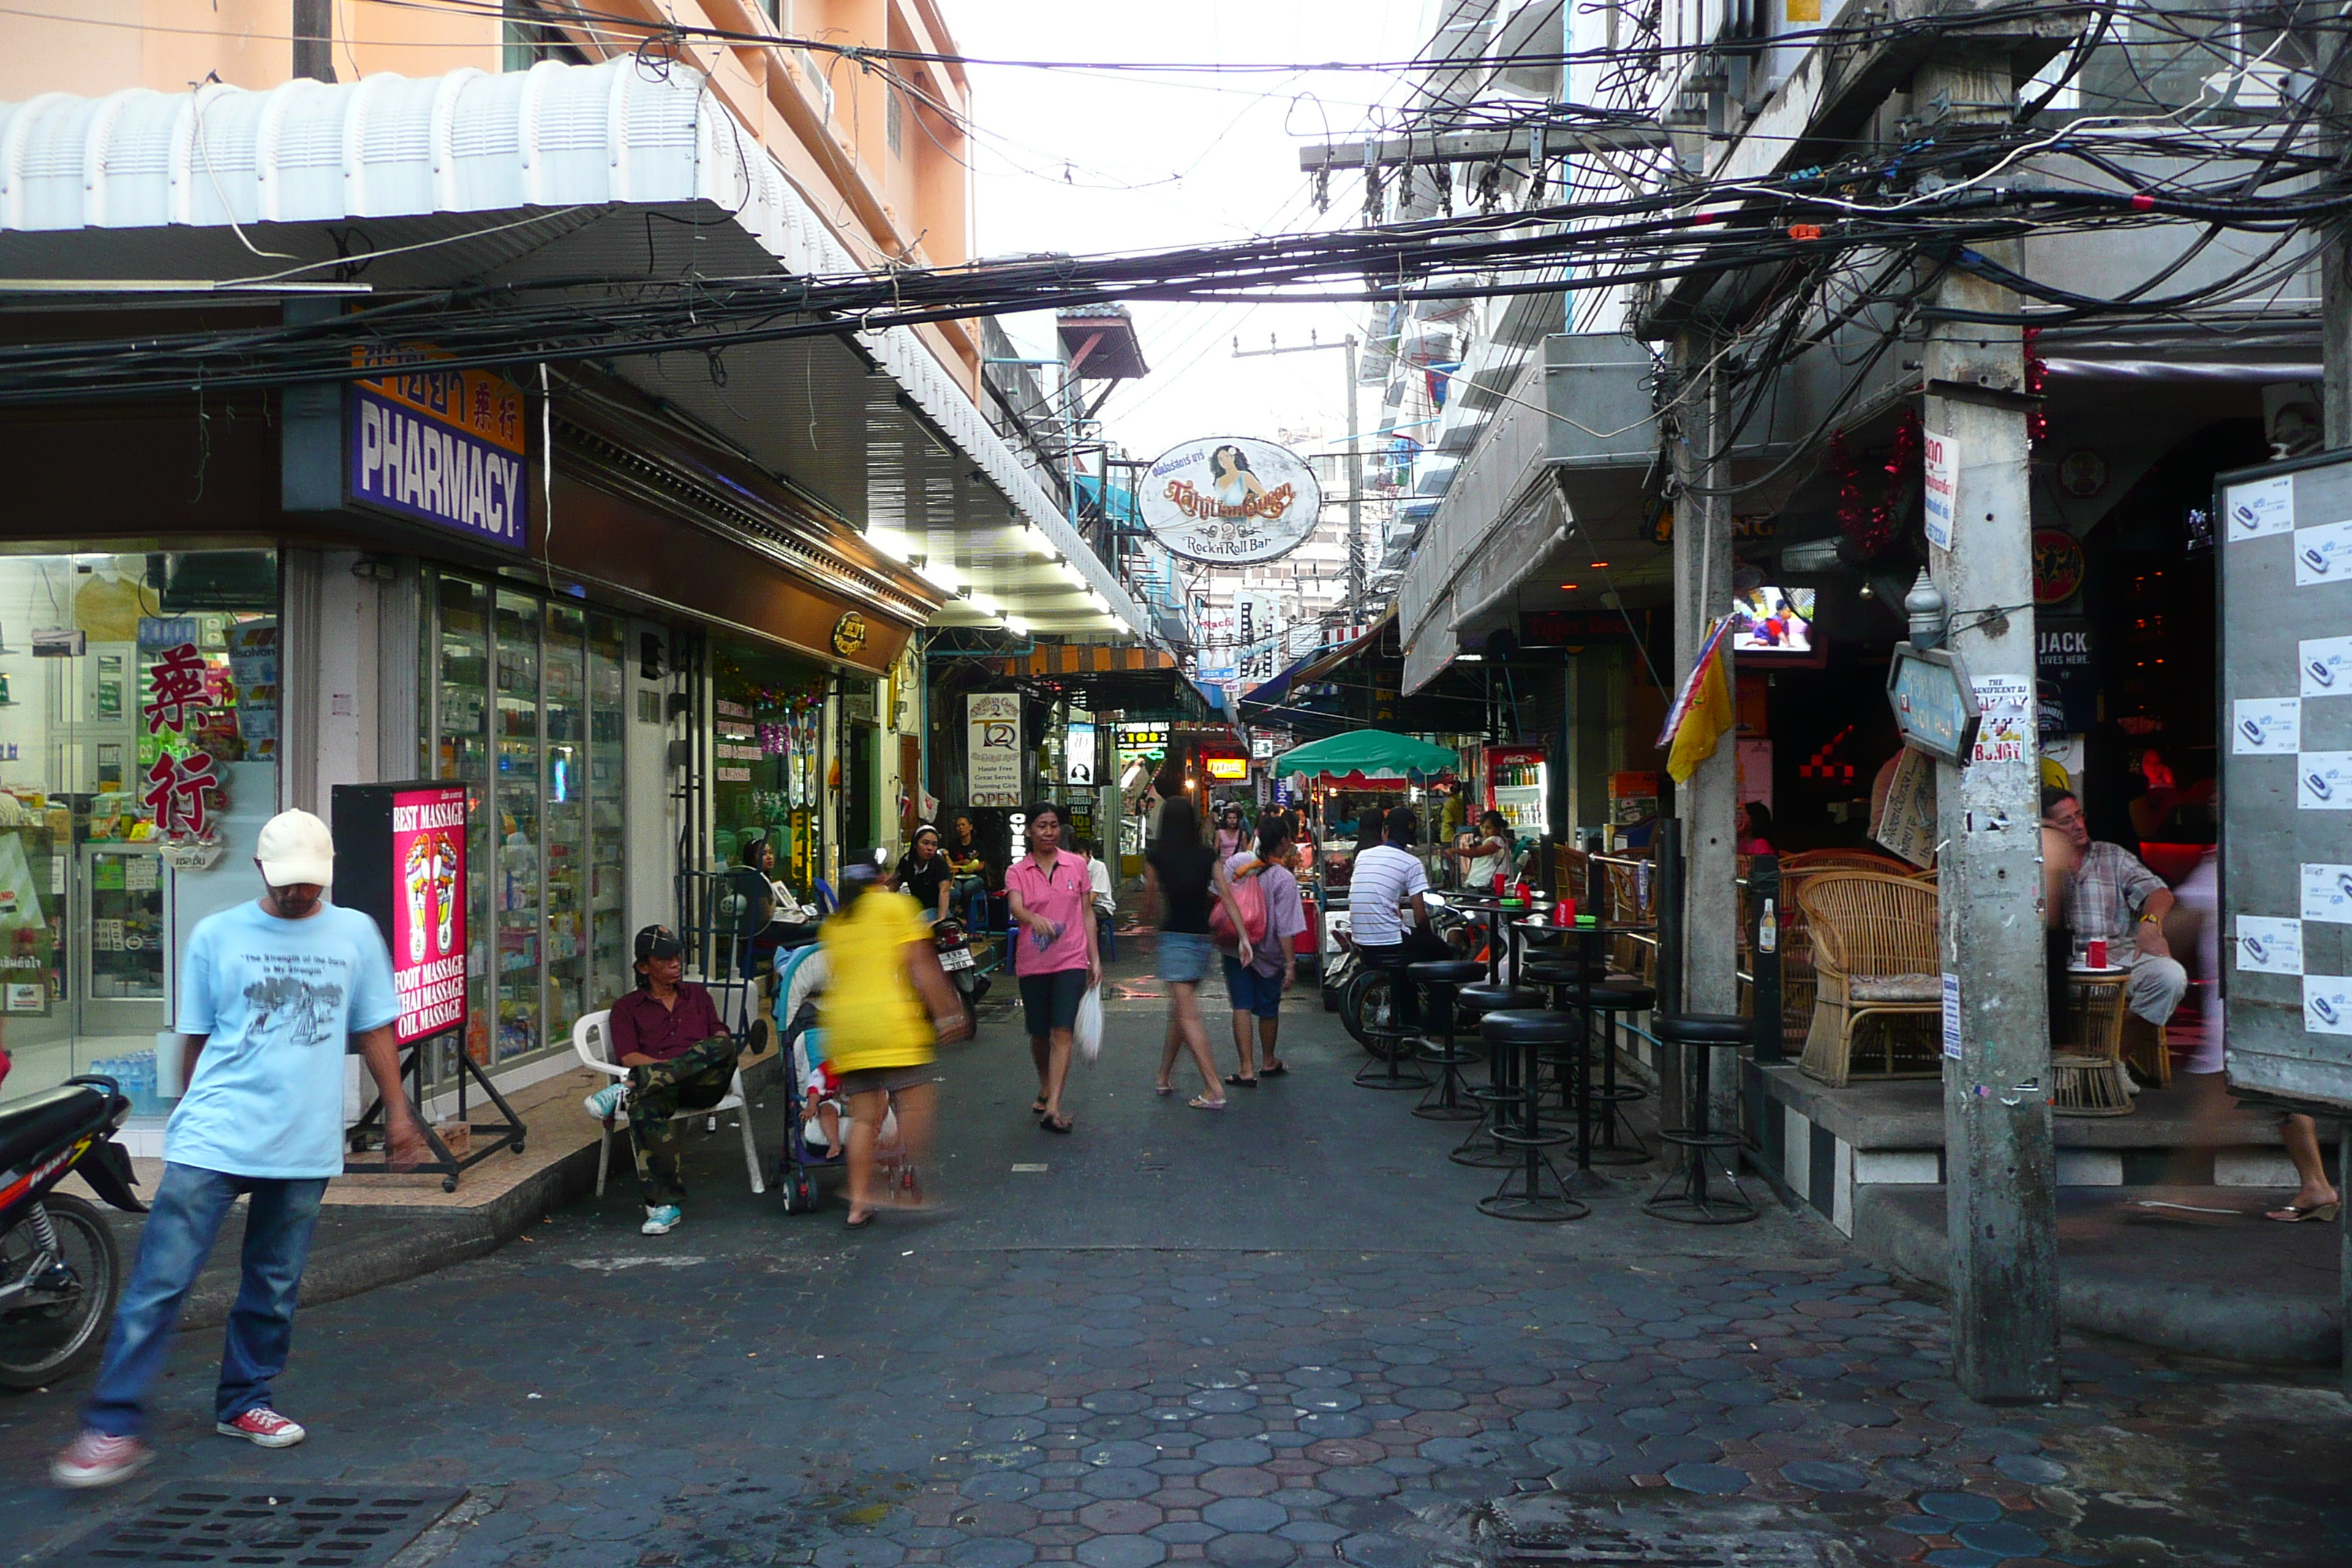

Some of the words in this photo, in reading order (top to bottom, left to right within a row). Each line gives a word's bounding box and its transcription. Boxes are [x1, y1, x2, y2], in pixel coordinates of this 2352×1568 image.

[361, 399, 519, 538] PHARMACY
[1221, 521, 1236, 540] 2
[1249, 538, 1272, 549] Bar
[2039, 632, 2088, 654] JACK
[2040, 656, 2064, 665] LIVES
[971, 791, 1020, 806] OPEN
[1066, 796, 1092, 805] OVERSEAS
[393, 805, 418, 833] BEST
[419, 802, 464, 830] MASSAGE
[1071, 805, 1088, 815] CALLS
[264, 953, 300, 963] Strength
[302, 954, 310, 962] of
[313, 954, 325, 964] the
[274, 965, 284, 973] My
[395, 965, 421, 993] FOOT
[422, 954, 464, 986] MASSAGE
[423, 976, 464, 1009] MASSAGE
[398, 1012, 419, 1039] OIL
[419, 998, 461, 1031] MASSAGE
